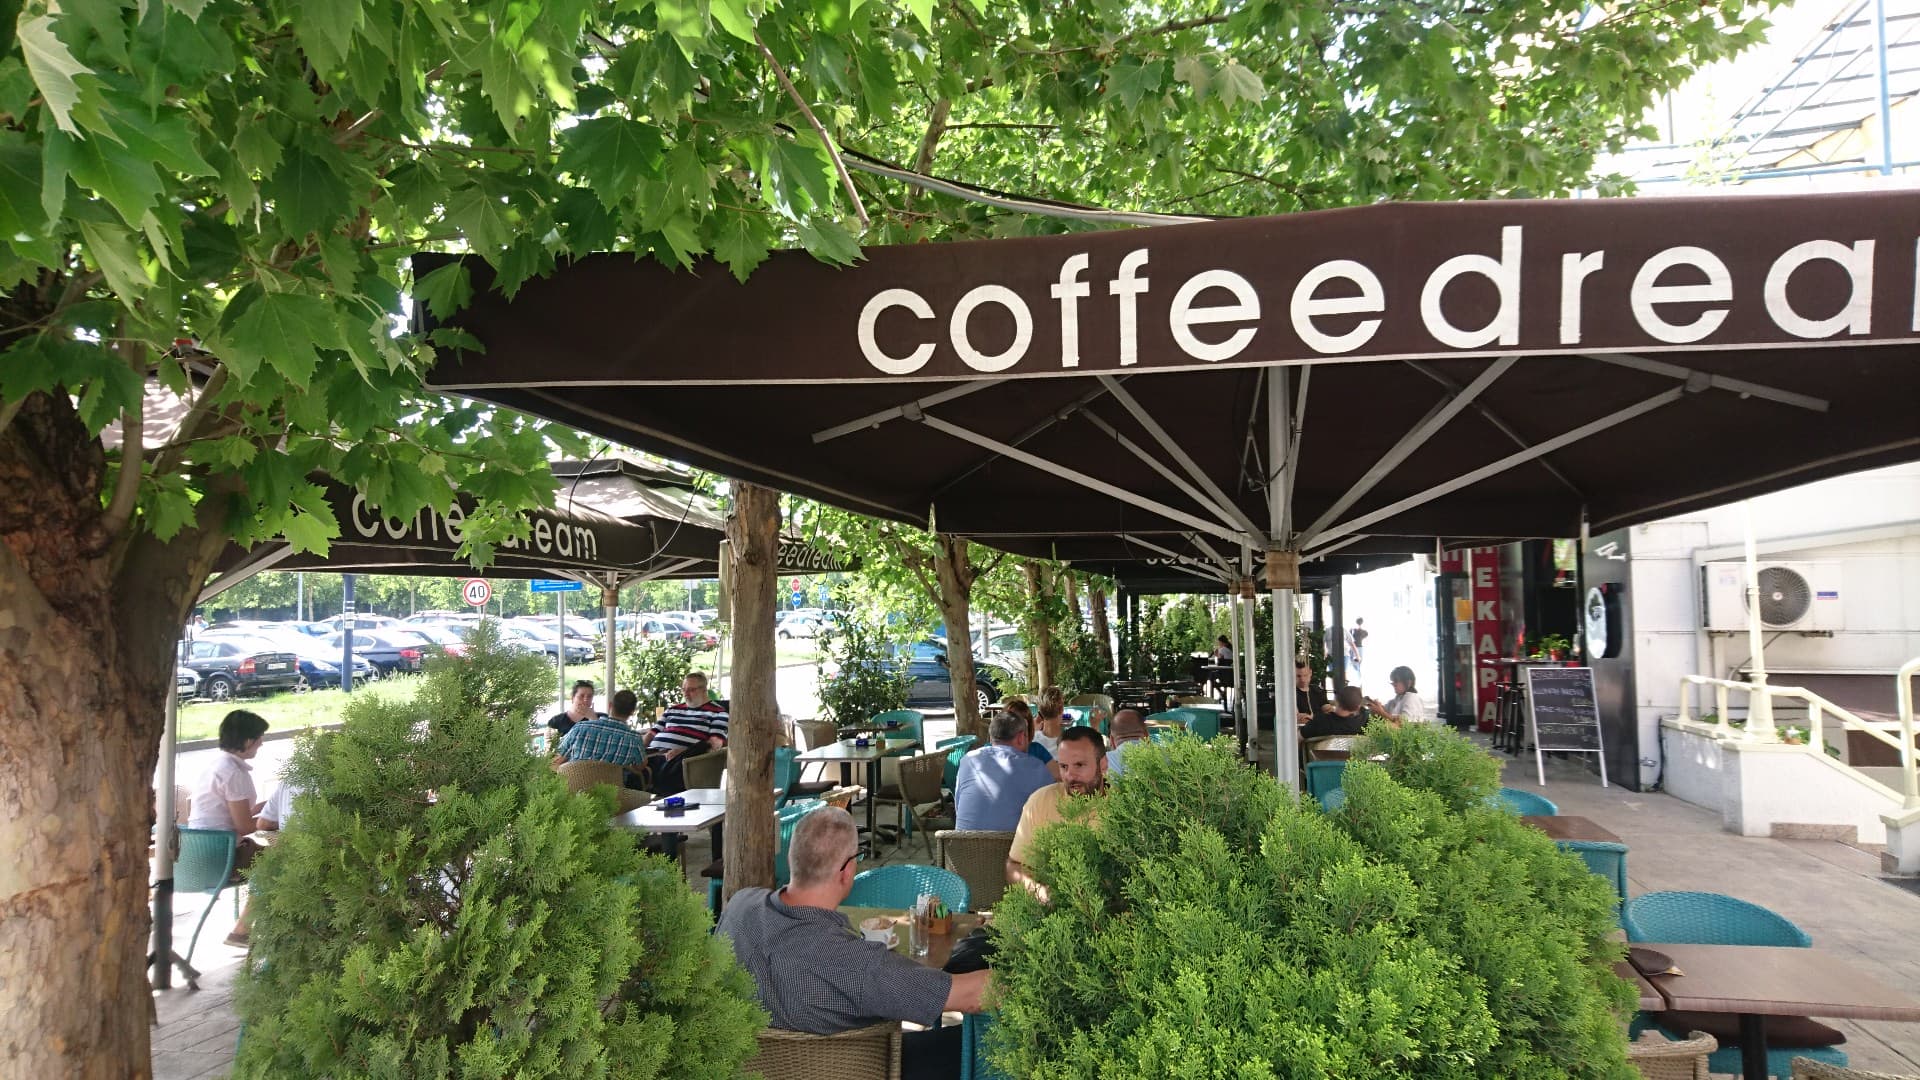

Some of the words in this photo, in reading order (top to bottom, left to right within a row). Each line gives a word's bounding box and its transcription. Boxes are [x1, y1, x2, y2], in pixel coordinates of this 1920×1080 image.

[857, 225, 1920, 374] coffeedrea
[351, 492, 598, 561] coeeam
[468, 585, 486, 599] 40
[1473, 546, 1498, 722] ЕКАРА
